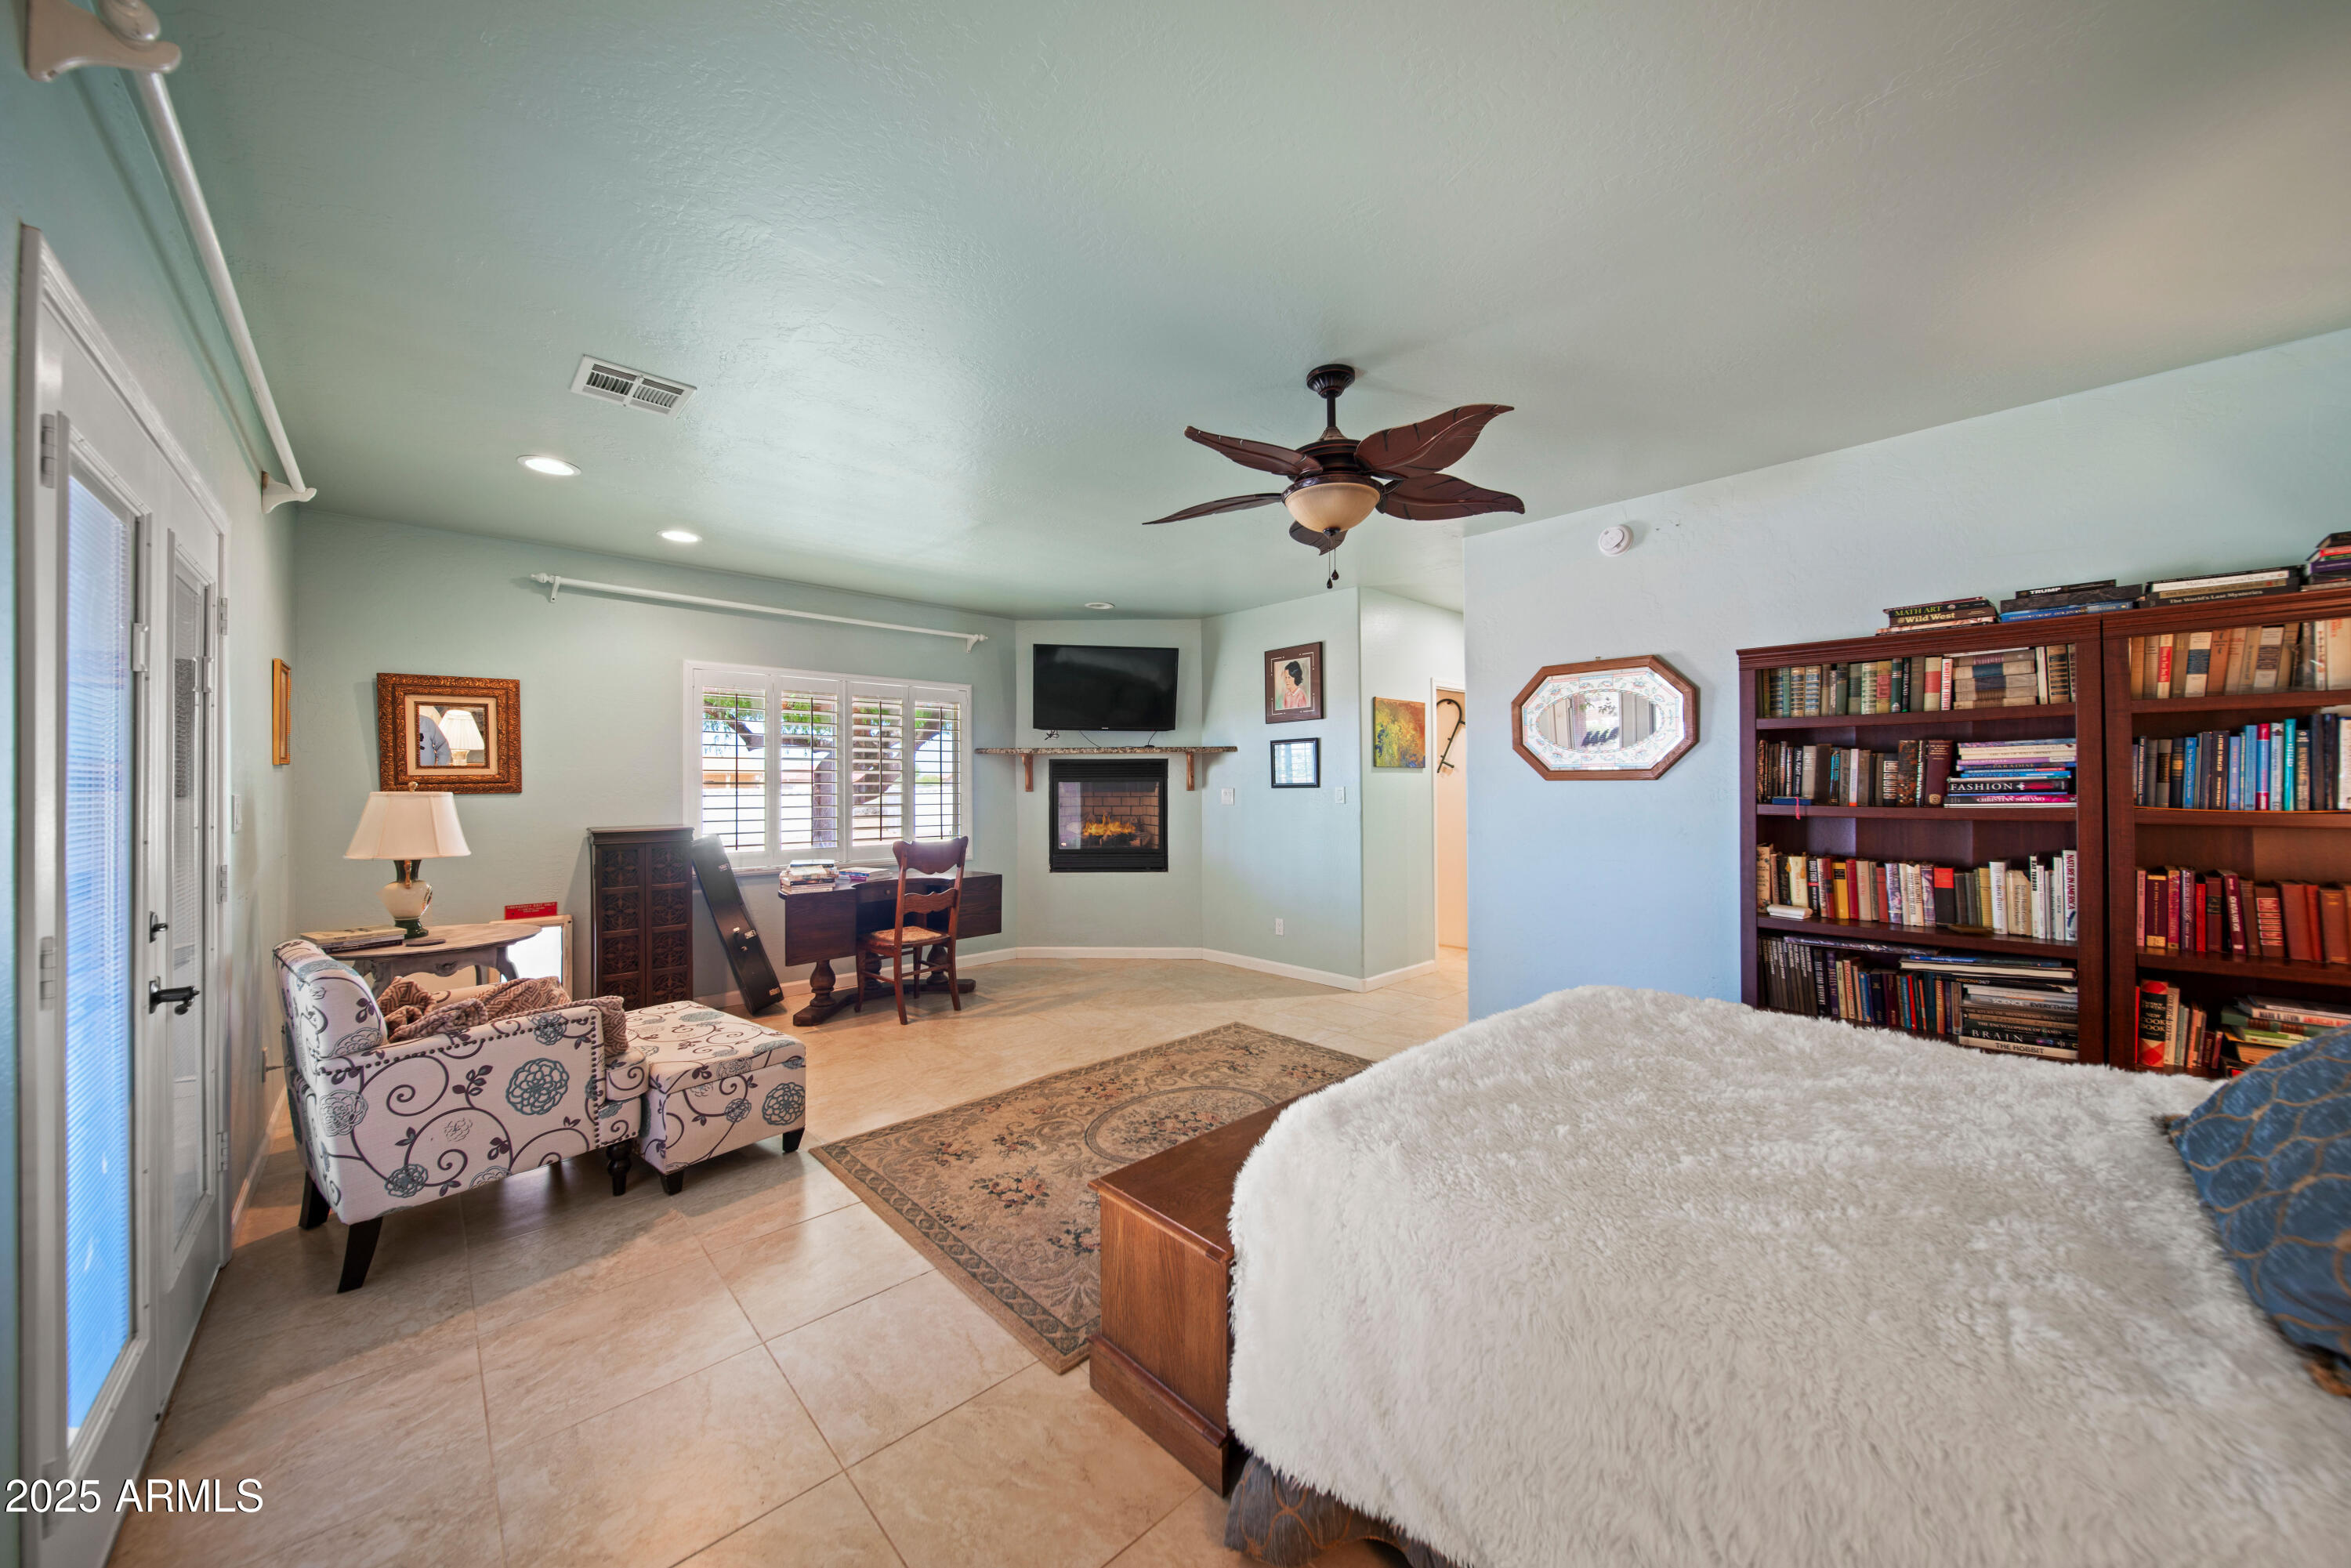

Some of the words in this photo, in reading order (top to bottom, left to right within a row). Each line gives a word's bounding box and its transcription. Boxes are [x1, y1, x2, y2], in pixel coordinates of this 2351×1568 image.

[1894, 608, 1922, 617] MATH
[1923, 606, 1943, 614] ART
[1904, 614, 1929, 624] Wild
[1930, 612, 1955, 621] West
[1951, 782, 2013, 791] FASHION
[2067, 854, 2075, 877] NATURE
[2067, 883, 2076, 910] AMERICA
[1827, 968, 1837, 986] ANGELS
[1991, 998, 2025, 1007] SCIENCE
[2030, 1002, 2078, 1012] EVERYTHING
[1989, 1023, 2032, 1032] ENCYCLOPEDIA
[1971, 1029, 2024, 1043] BRAIN
[1995, 1042, 2012, 1051] THE
[2012, 1044, 2045, 1055] HOBBIT
